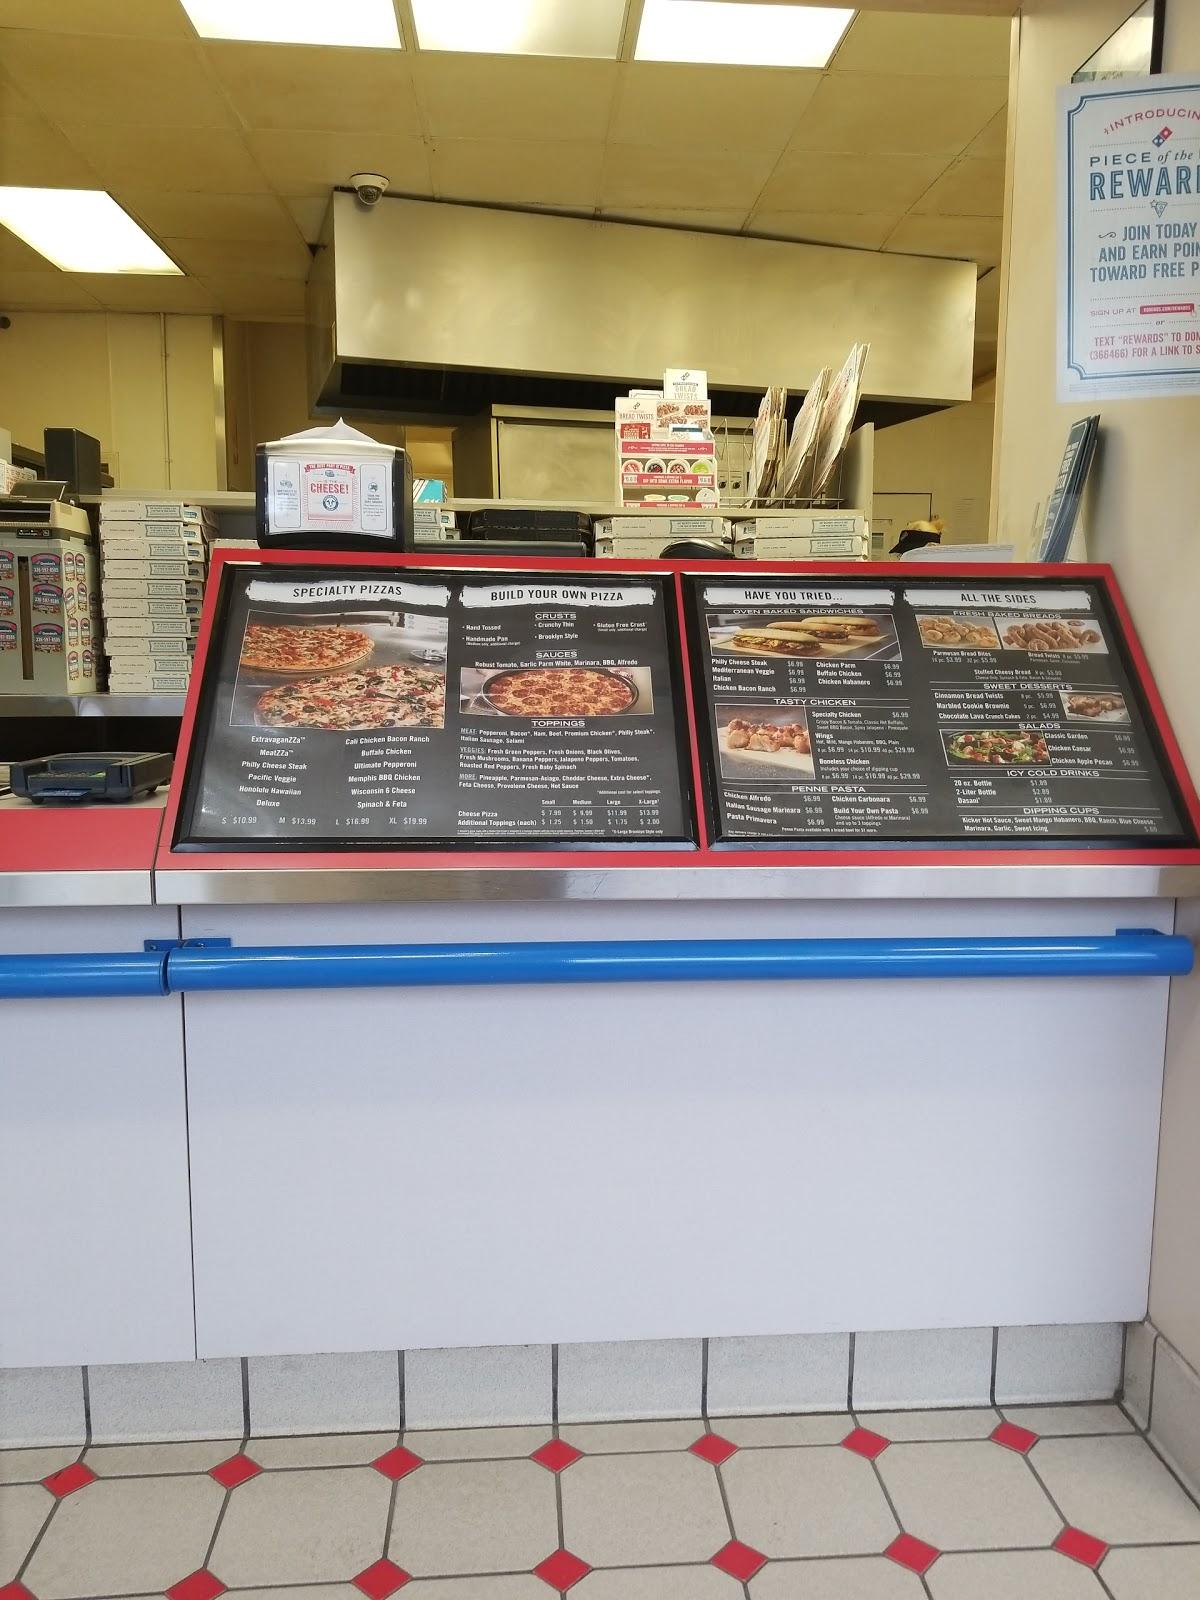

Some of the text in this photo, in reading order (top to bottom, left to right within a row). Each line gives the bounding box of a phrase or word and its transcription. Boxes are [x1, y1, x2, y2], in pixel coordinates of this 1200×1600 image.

[1090, 150, 1194, 167] PIECE of the
[1090, 165, 1200, 201] REWAR
[1122, 222, 1197, 241] JOIN TODAY
[1098, 245, 1126, 262] AND
[1132, 243, 1167, 260] EARN
[1090, 264, 1147, 283] TOWARD
[1153, 262, 1185, 278] FREE
[1090, 309, 1110, 317] SIGN
[1094, 336, 1116, 347] TEXT
[1171, 332, 1182, 342] TO
[1132, 347, 1148, 358] FOR
[1151, 346, 1157, 356] A
[1160, 345, 1179, 356] LINK
[1182, 345, 1193, 355] TO
[310, 483, 349, 494] CHEESE!
[293, 584, 402, 597] SPECIALTY PIZZAS
[491, 589, 623, 601] BUILD YOUR OWN PIZZA
[744, 590, 843, 601] HAVE YOU TRIED...
[960, 593, 1037, 604] ALL THE SIDES
[711, 658, 728, 666] Philly
[359, 736, 386, 744] Chicken
[361, 749, 384, 757] Buffalo
[241, 760, 260, 769] Philly
[262, 762, 287, 770] Cheese
[354, 761, 417, 770] Ultimate Pepperoni
[248, 773, 297, 783] Pacific Veggie
[348, 775, 377, 783] Memphis
[394, 773, 421, 781] Chicken
[239, 785, 302, 795] Honolulu Hawaiian
[351, 787, 384, 795] Wisconsin
[723, 792, 772, 802] Chicken Alfredo
[256, 799, 280, 807] Deluxe
[357, 800, 384, 809] Spinach
[392, 800, 407, 808] Feta
[725, 801, 801, 814] Italian Sausage Marinara
[1070, 807, 1100, 815] CUPS
[232, 816, 257, 824] $10.99
[278, 816, 286, 824] M
[292, 817, 316, 826] $13.99
[346, 817, 370, 825] $16.99
[388, 816, 398, 825] XL
[403, 817, 428, 825] $19.99
[726, 812, 777, 824] Pasta Primavera
